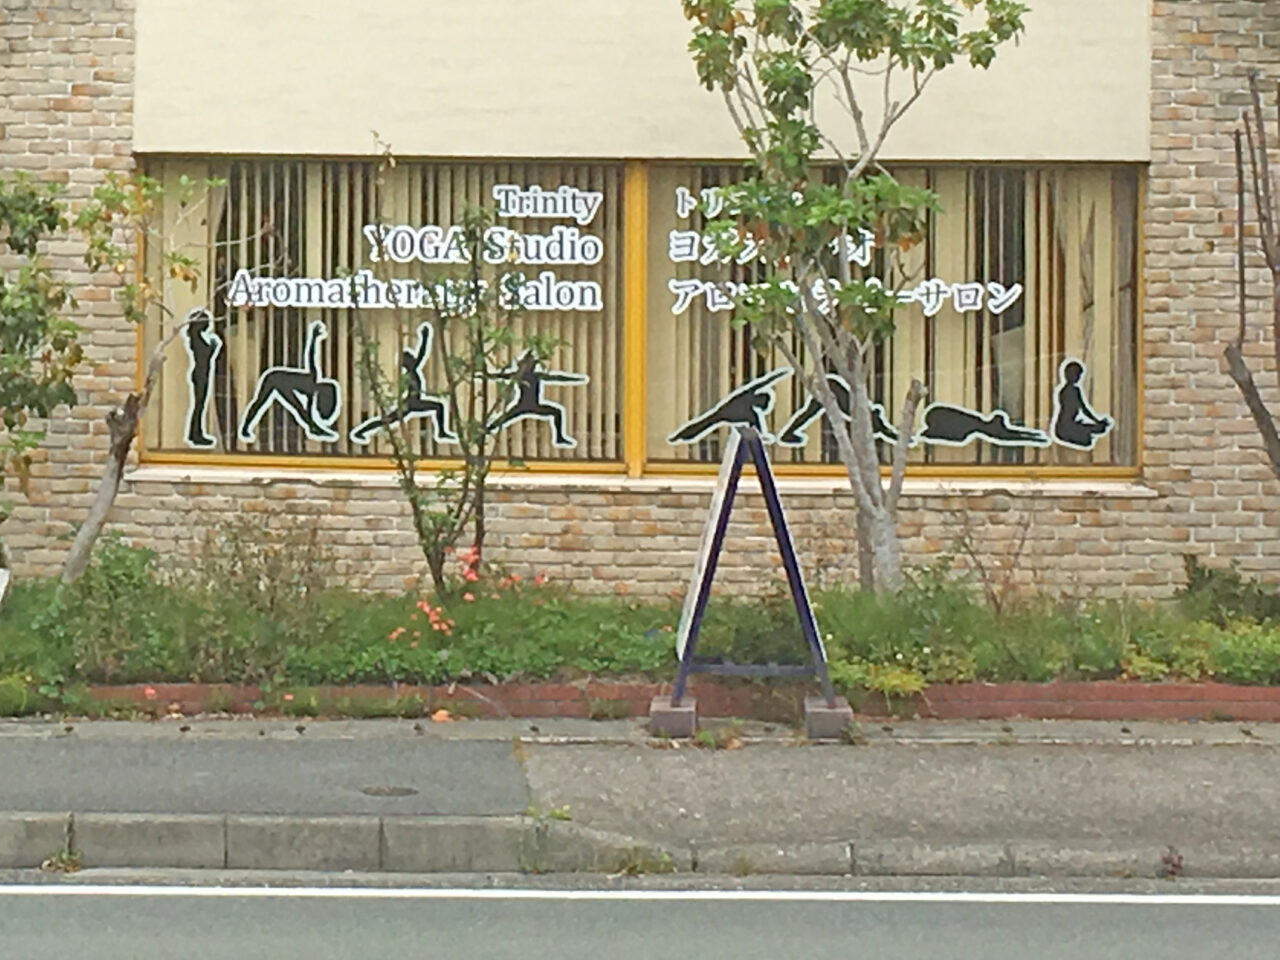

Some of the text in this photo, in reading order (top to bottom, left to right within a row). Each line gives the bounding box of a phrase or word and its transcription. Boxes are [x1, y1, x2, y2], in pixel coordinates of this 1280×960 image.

[494, 187, 602, 223] Trinity
[364, 226, 471, 262] YOGA
[229, 272, 489, 317] Aromaher
